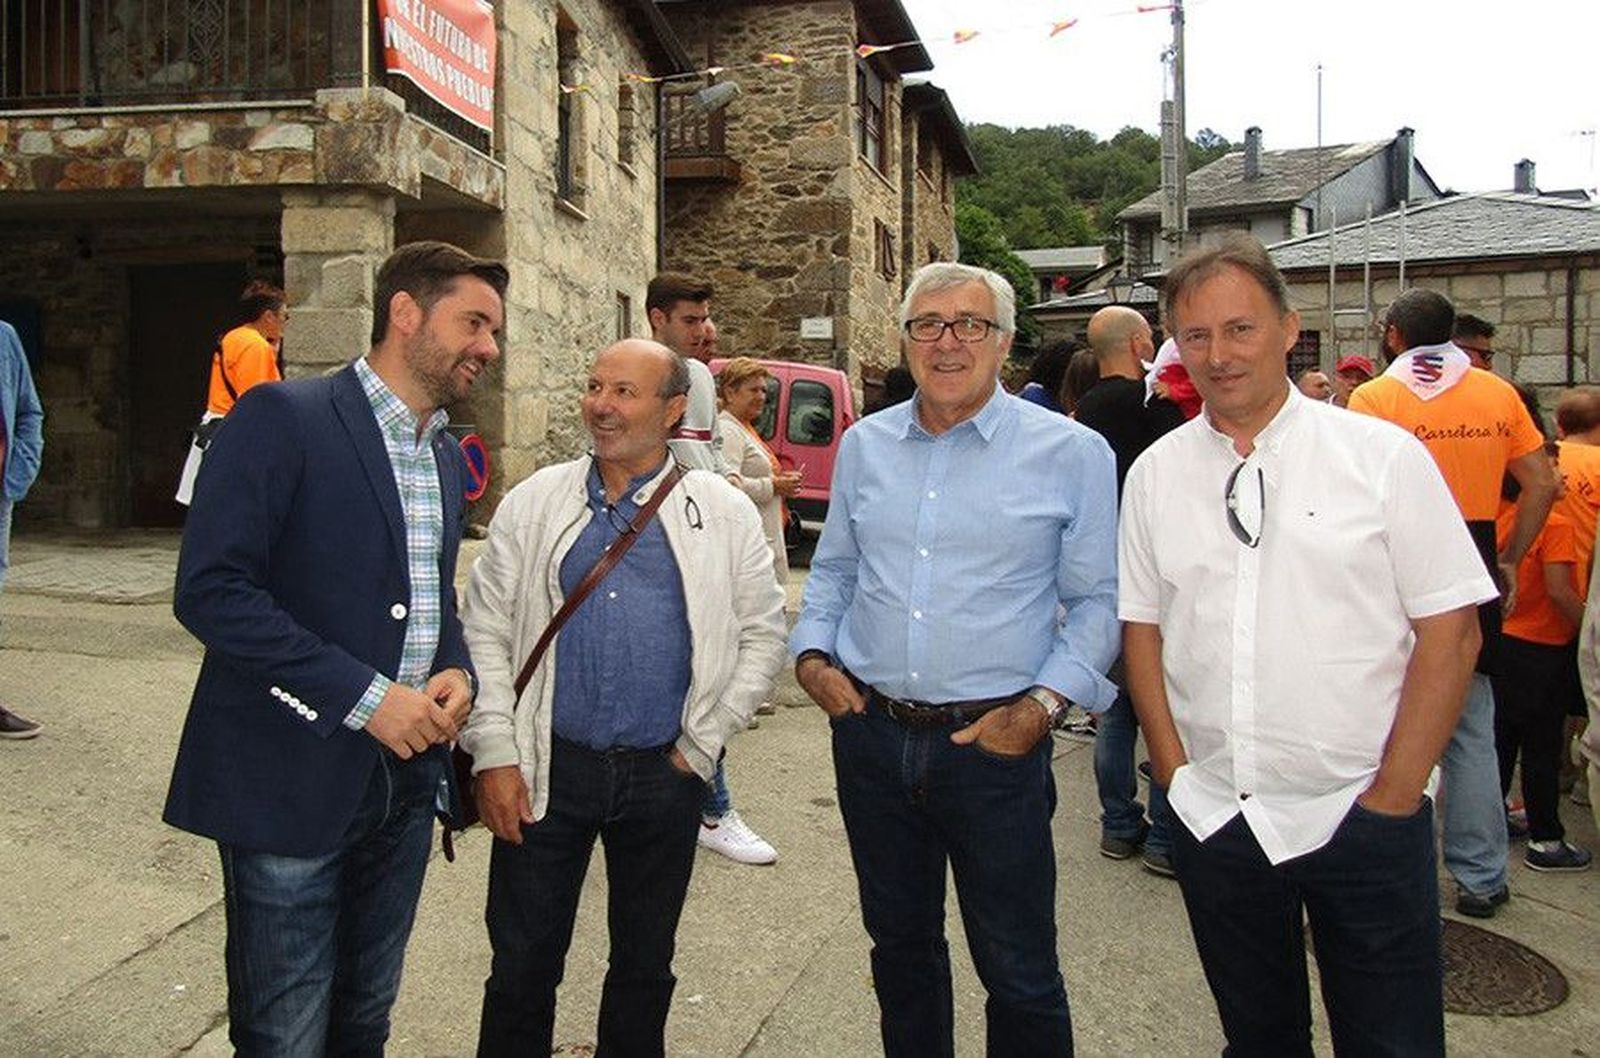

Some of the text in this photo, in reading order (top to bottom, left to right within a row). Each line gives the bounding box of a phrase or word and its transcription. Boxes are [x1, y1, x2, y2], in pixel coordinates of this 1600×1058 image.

[429, 10, 471, 63] FUTURO
[472, 42, 490, 74] DE
[446, 63, 494, 111] PUEBLO
[1414, 424, 1492, 441] Carretera
